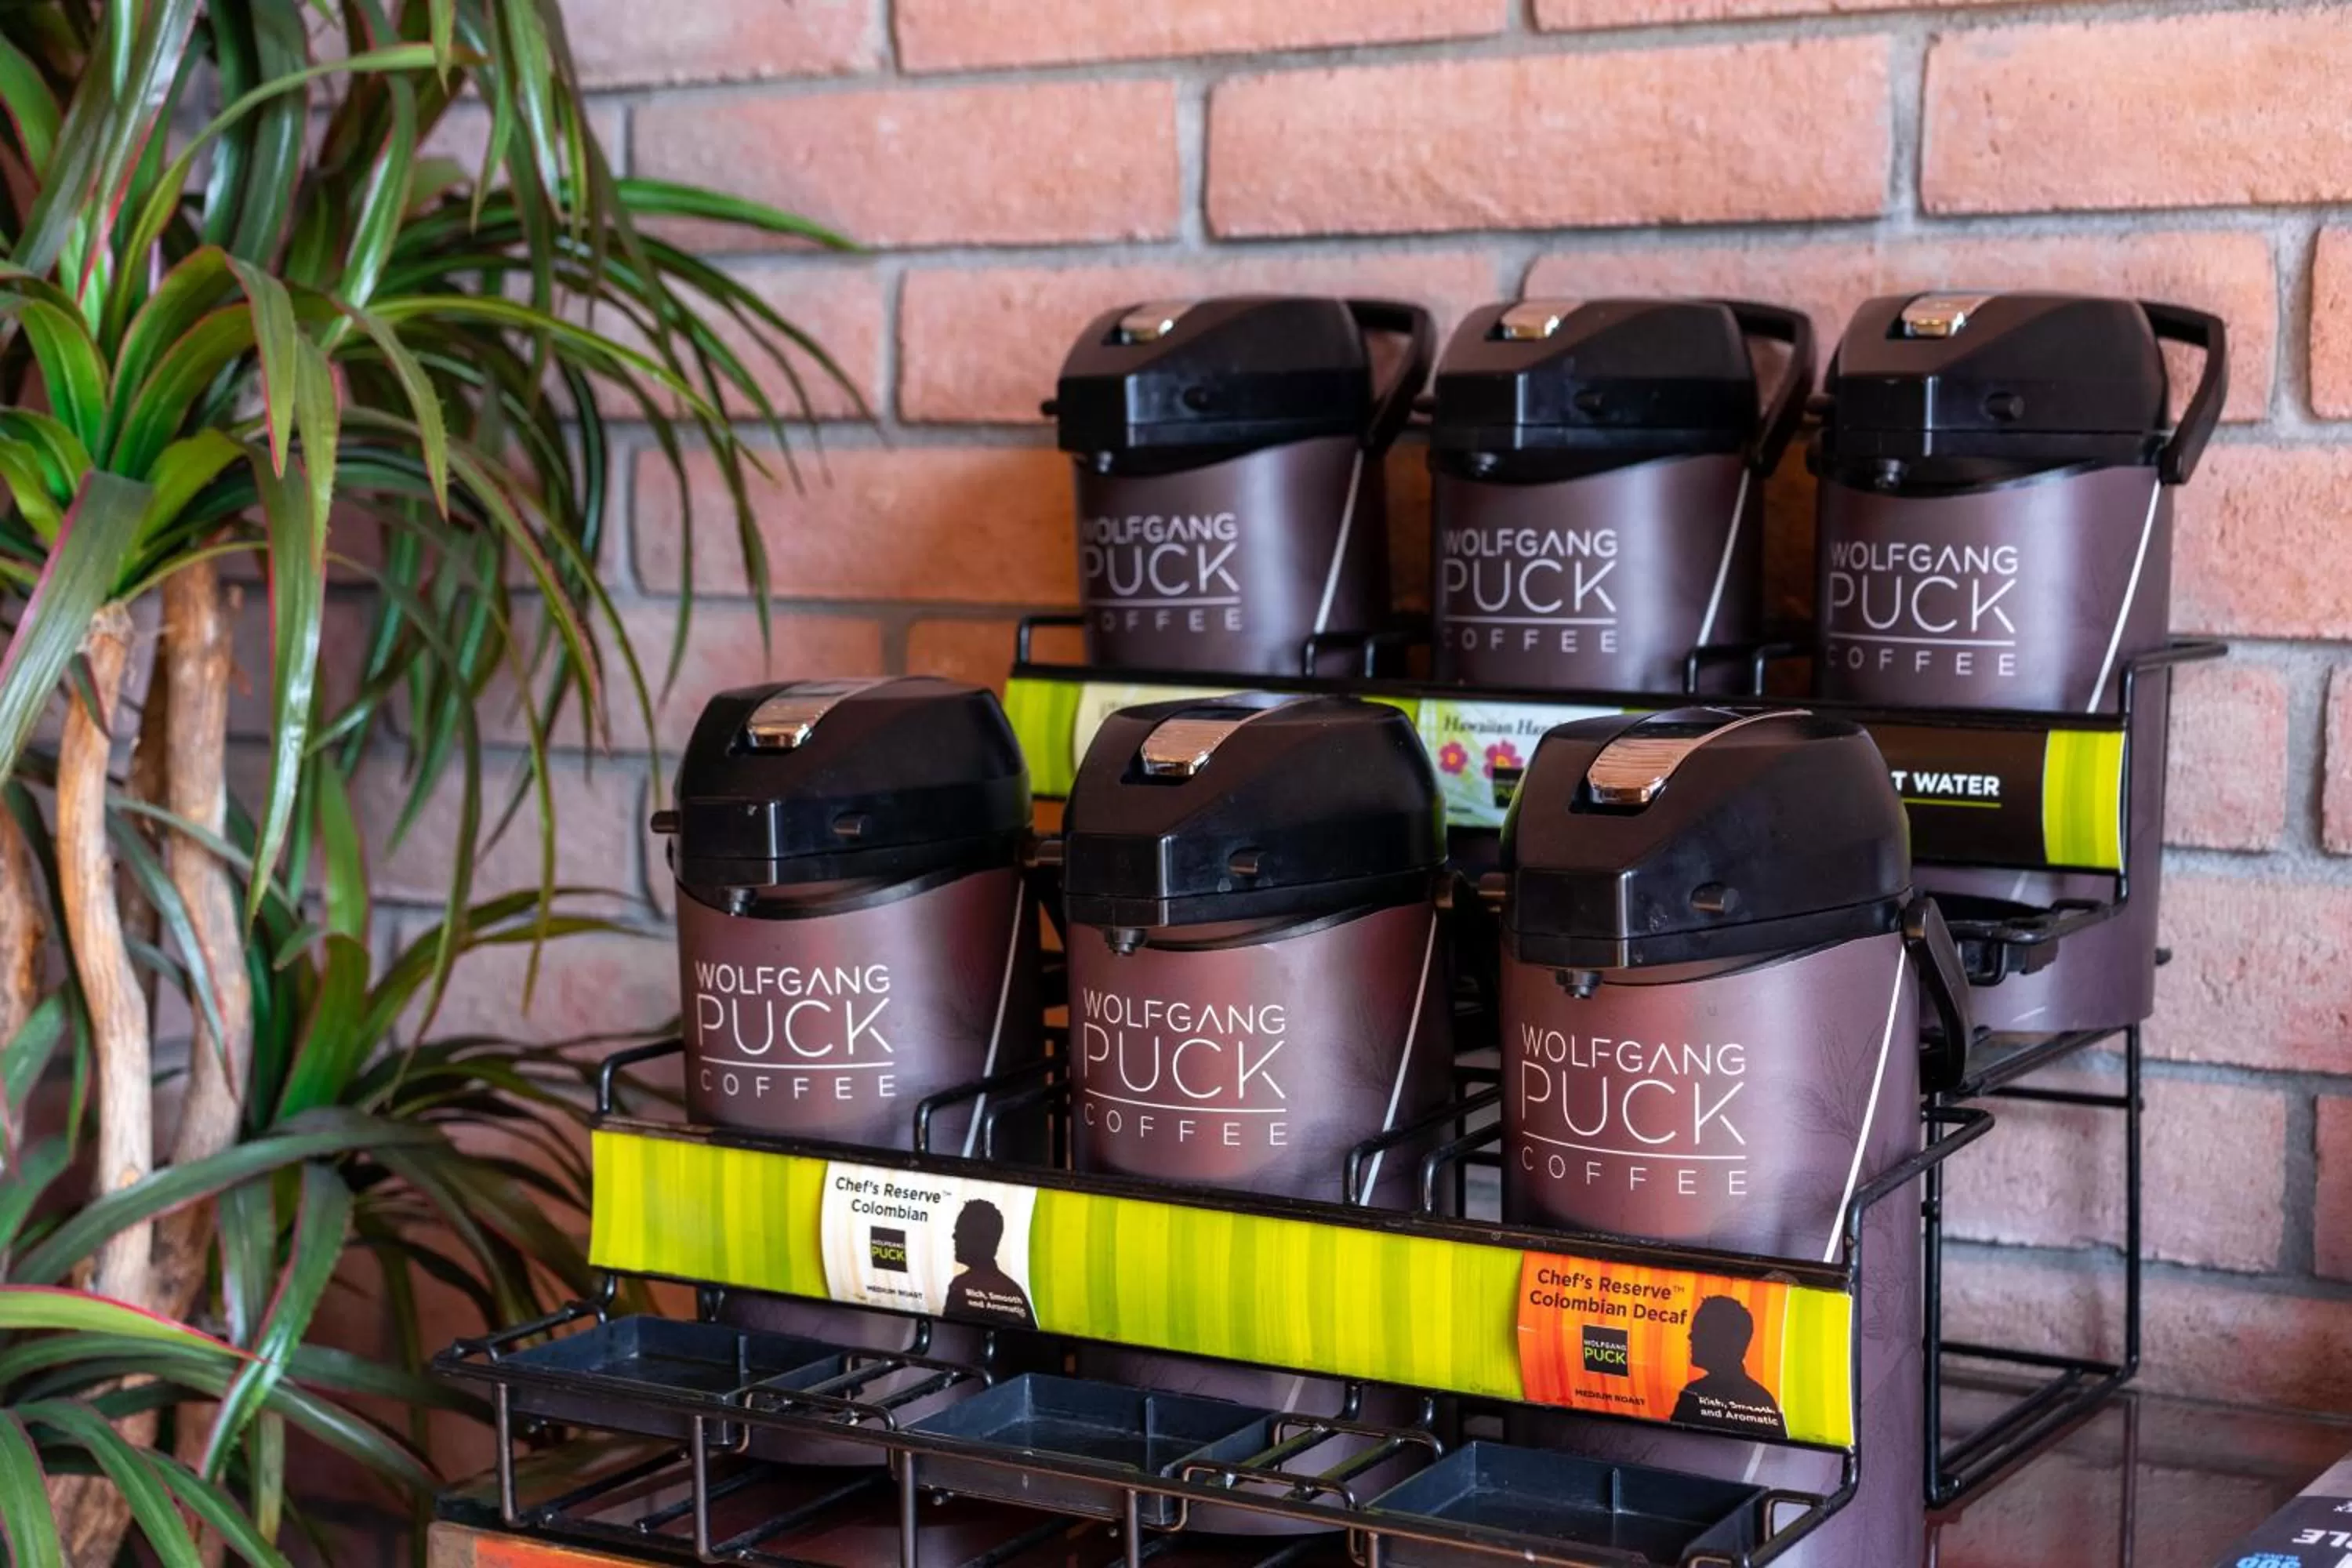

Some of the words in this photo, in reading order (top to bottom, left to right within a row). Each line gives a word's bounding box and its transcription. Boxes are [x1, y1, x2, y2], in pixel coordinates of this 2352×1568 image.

[1443, 528, 1618, 557] WOLFGANG
[1831, 541, 2018, 575] WOLFGANG
[1081, 542, 1240, 596] PUCK
[1443, 557, 1617, 613] PUCK
[1828, 572, 2016, 633] PUCK
[1828, 644, 2016, 677] COFFEE
[1444, 714, 1513, 734] Hawaiian
[1912, 771, 2001, 797] WATER
[695, 960, 891, 996] WOLFGANG
[696, 993, 894, 1058] PUCK
[1083, 988, 1286, 1034] WOLFGANG
[1083, 1022, 1287, 1100] PUCK
[1522, 1022, 1746, 1076] WOLFGANG
[700, 1068, 897, 1099] COFFEE
[1522, 1060, 1746, 1145] PUCK
[1084, 1102, 1288, 1145] COFFEE
[836, 1177, 879, 1195] Chef's
[1522, 1146, 1748, 1195] COFFEE
[851, 1199, 928, 1222] Colombian
[871, 1247, 906, 1261] PUCK
[1530, 1290, 1628, 1318] Colombian
[1633, 1305, 1688, 1325] Decaf
[1584, 1340, 1627, 1350] WOLFGANG
[1584, 1347, 1627, 1365] PUCK
[1575, 1388, 1613, 1402] MEDIUM
[1614, 1395, 1646, 1406] ROAST
[1700, 1409, 1722, 1418] and
[1726, 1412, 1779, 1426] Aromatic
